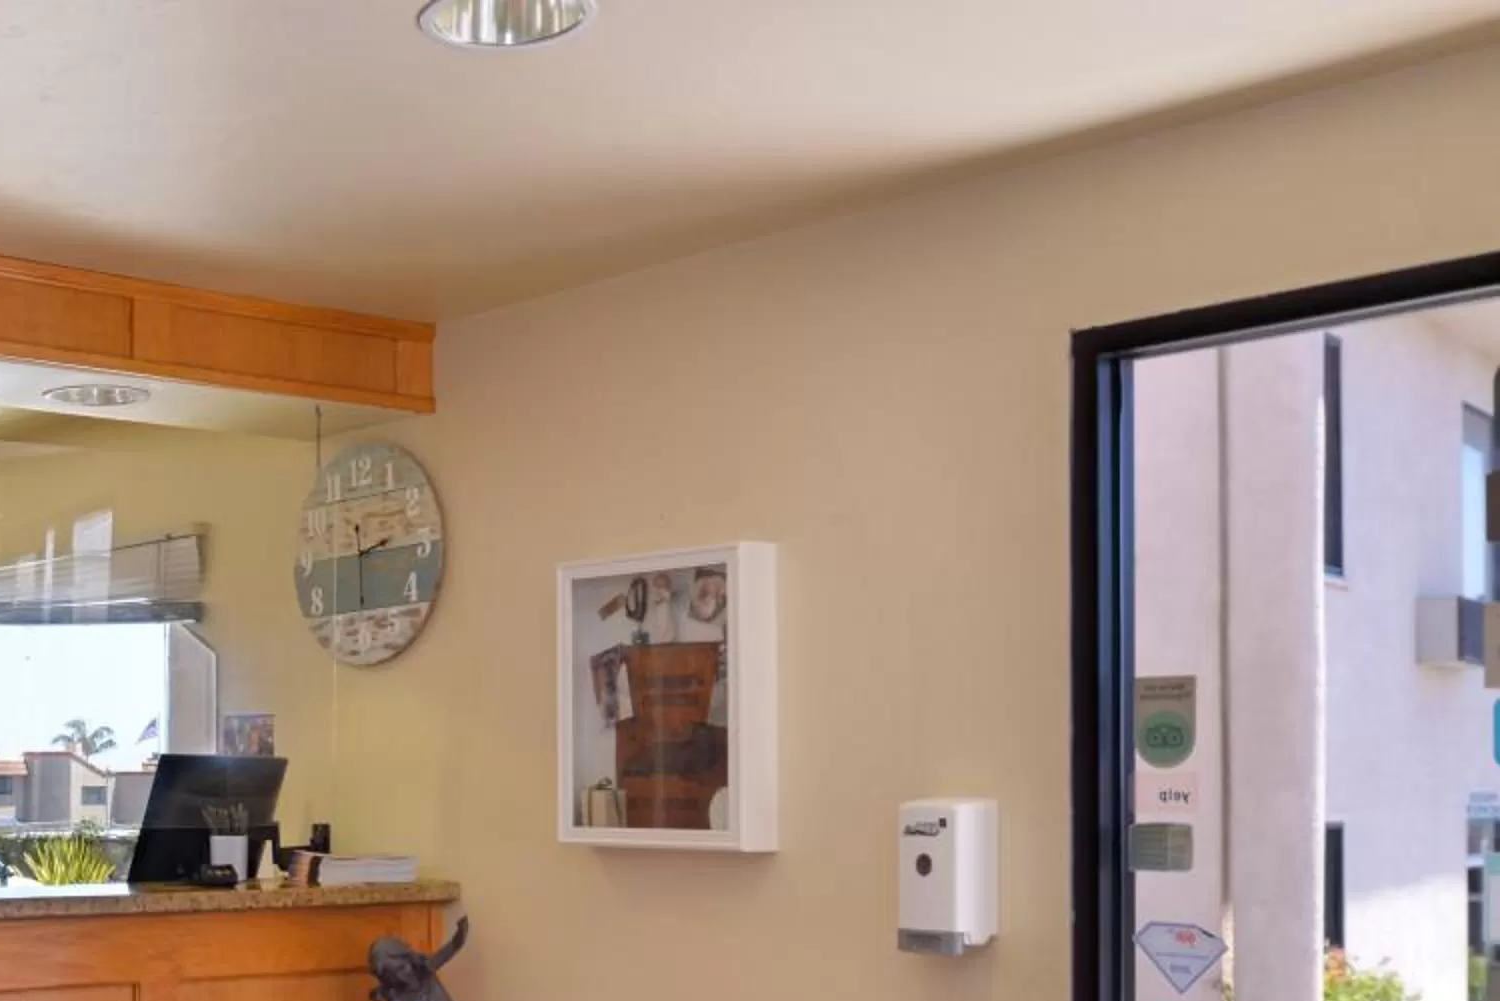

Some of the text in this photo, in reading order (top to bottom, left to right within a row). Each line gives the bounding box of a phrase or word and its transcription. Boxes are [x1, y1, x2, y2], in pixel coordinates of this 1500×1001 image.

[349, 456, 373, 486] 12
[385, 460, 395, 489] 1
[326, 474, 341, 502] 11
[405, 488, 420, 516] 2
[307, 510, 327, 537] 10
[416, 528, 431, 558] 3
[403, 572, 419, 601] 4
[310, 587, 323, 615] 8
